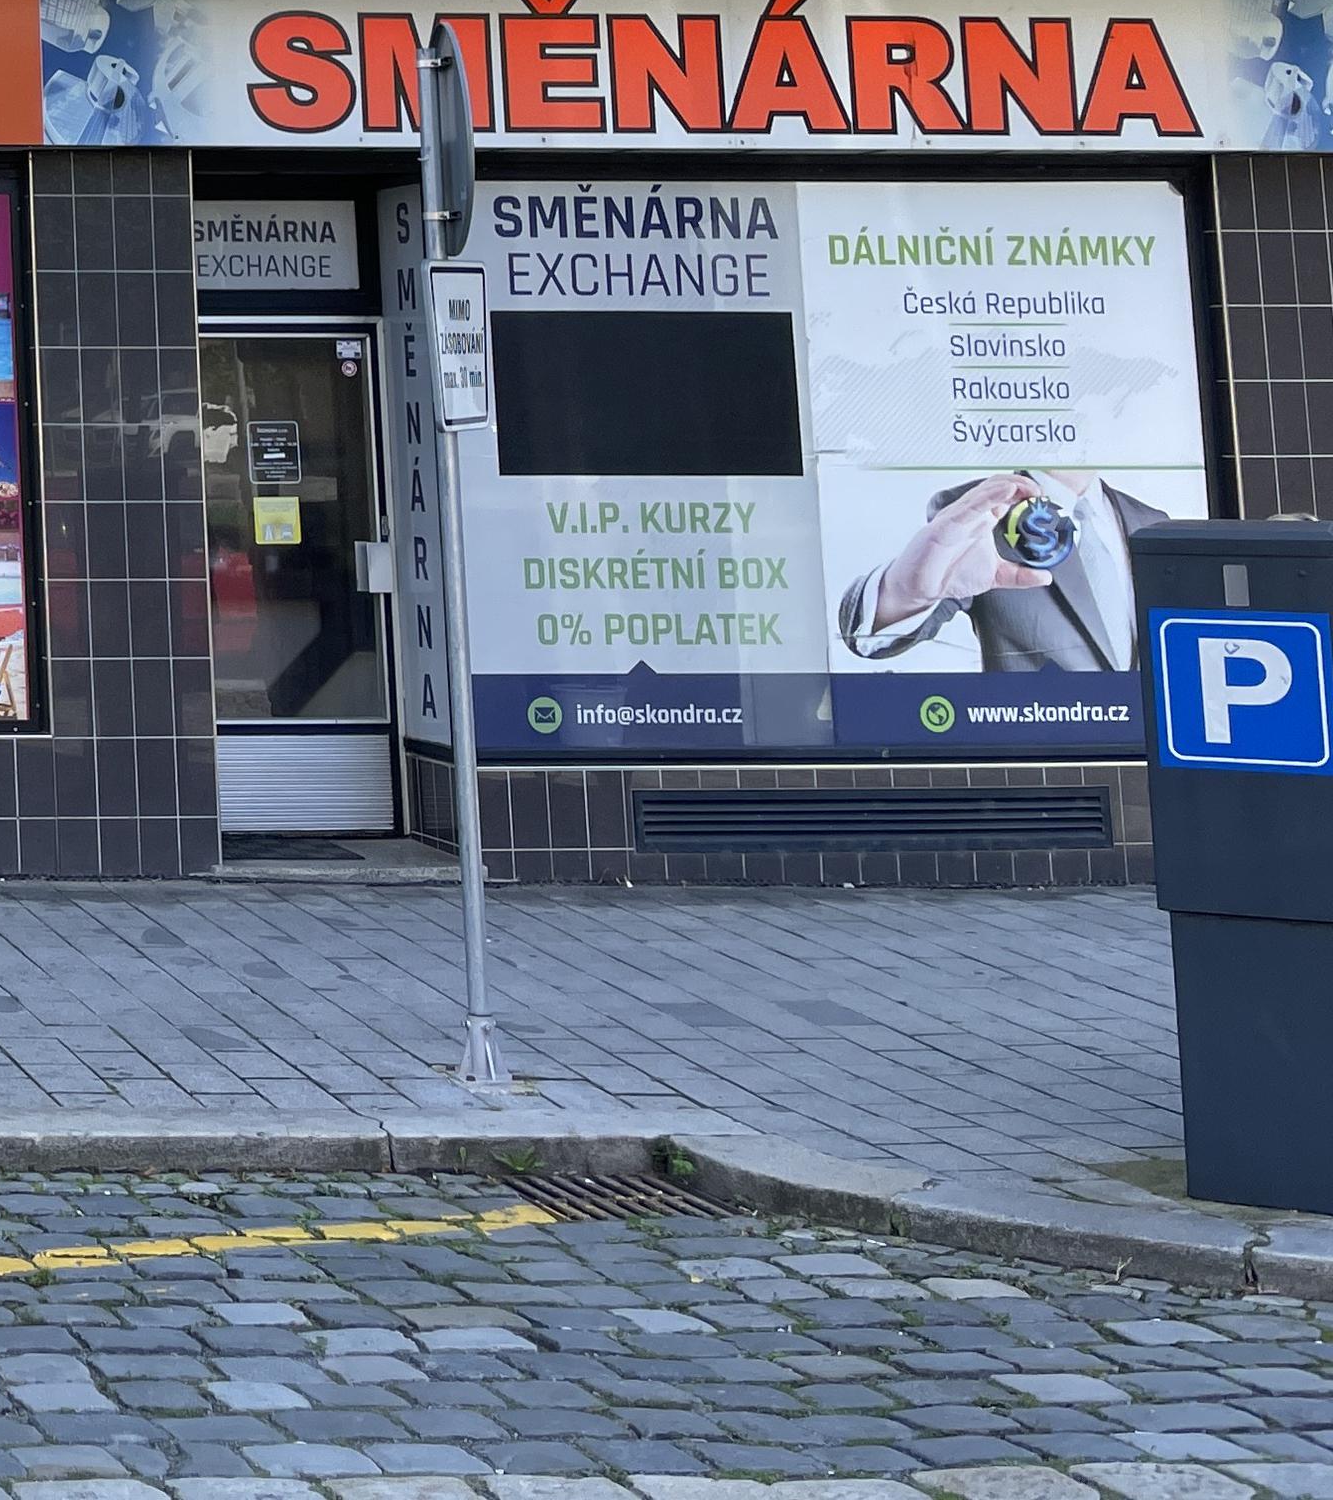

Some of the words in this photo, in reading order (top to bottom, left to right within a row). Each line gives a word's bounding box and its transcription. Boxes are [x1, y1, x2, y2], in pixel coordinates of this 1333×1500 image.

[194, 213, 336, 243] SMĚNÁRNA
[493, 184, 779, 240] SMĚNÁRNA
[828, 226, 993, 266] DÁLNIČNÍ
[1006, 226, 1156, 266] ZNÁMKY
[197, 254, 332, 278] EXCHANGE
[508, 252, 770, 297] EXCHANGE
[448, 298, 471, 322] MIMO
[903, 285, 976, 315] Česká
[986, 291, 1105, 319] Republika
[950, 333, 1065, 358] Slovinsko
[953, 376, 1070, 400] Rakousko
[953, 414, 1076, 447] Švýcarsko
[546, 502, 629, 534] V.I.P.
[640, 502, 756, 534] KURZY
[523, 548, 706, 590] DISKRÉTNÍ
[718, 557, 789, 590] BOX
[537, 612, 592, 646] 0%
[605, 612, 783, 646] POPLATEK
[1197, 637, 1293, 745] P
[576, 703, 743, 726] info@skondra.cz
[967, 701, 1130, 723] www.skondra.cz
